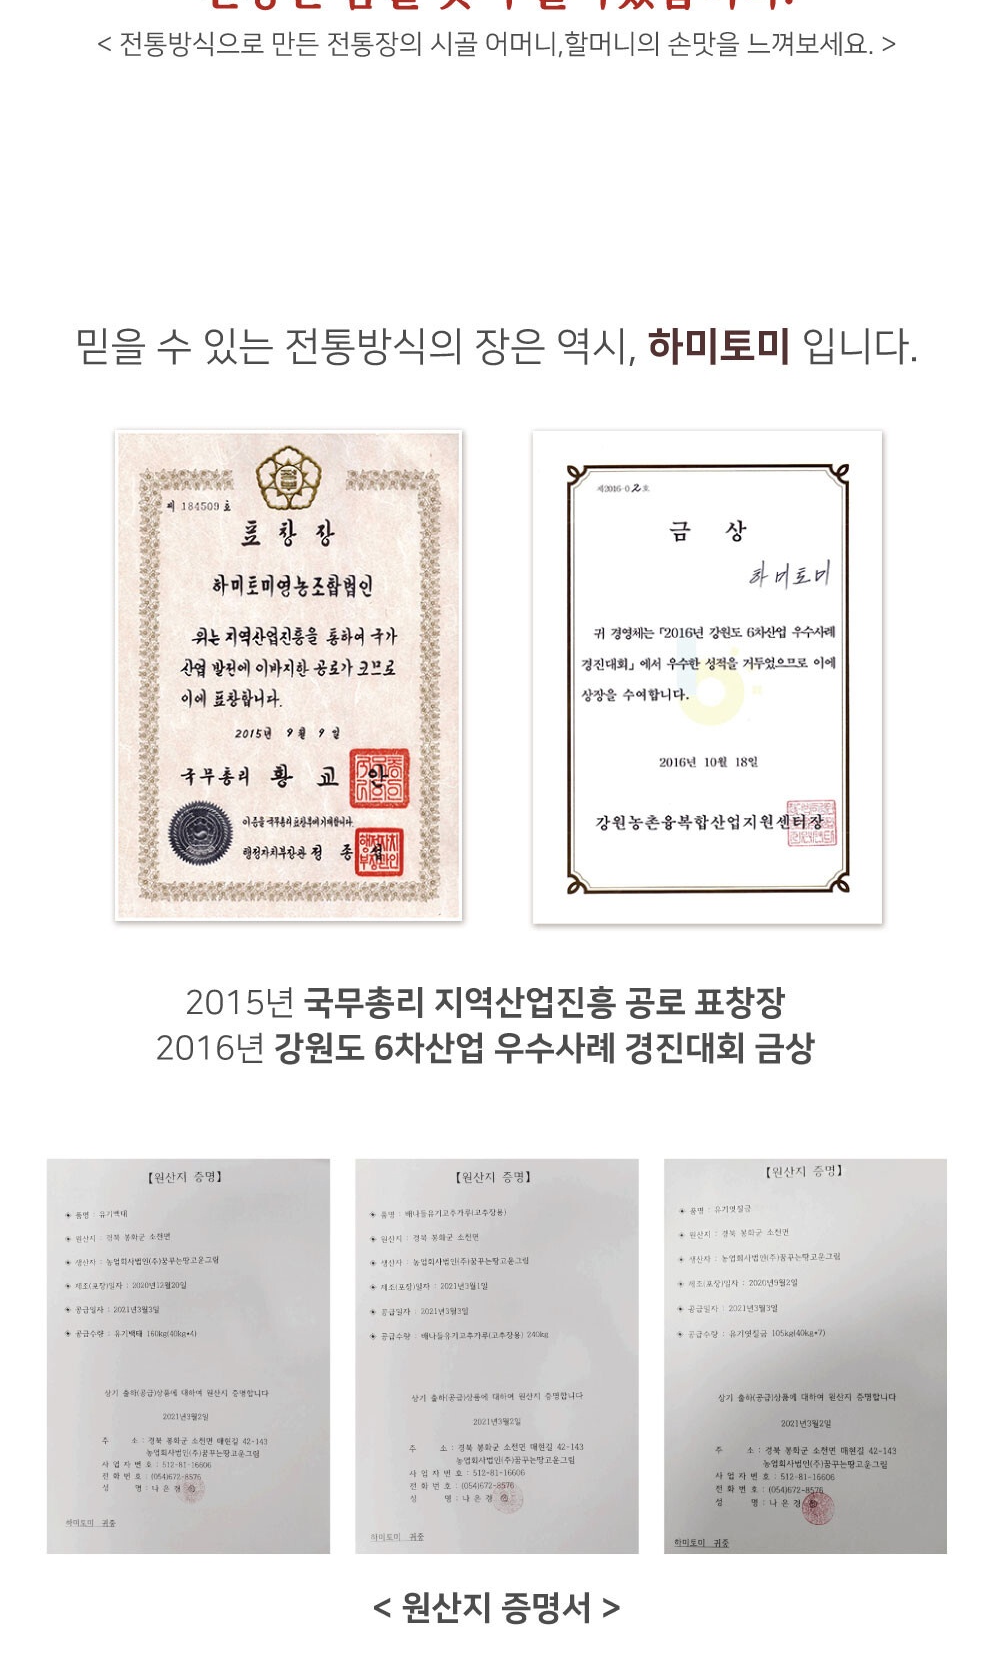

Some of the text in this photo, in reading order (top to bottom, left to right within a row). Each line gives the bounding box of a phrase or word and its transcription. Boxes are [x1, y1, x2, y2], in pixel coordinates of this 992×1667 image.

[213, 574, 372, 598] 하미토미영농조합법인
[192, 626, 398, 647] 위는 지역산업진흥을 통하여 국가
[611, 627, 655, 640] 경영체는
[660, 626, 703, 639] 「2016년
[709, 626, 742, 639] 강원도
[747, 626, 786, 639] 6차산업
[792, 625, 835, 638] 우수사례
[180, 658, 396, 678] 산업 발전에 이바지한 공로가 크므로
[582, 656, 836, 671] 경진대회」 에서 우수한 성적을 거두었으므로 이에
[181, 688, 282, 708] 이에 표창합니다.
[582, 688, 689, 702] 상장을 수여합니다.
[660, 756, 758, 767] 2016년 10월 18일
[596, 814, 824, 832] 강원농촌융복합산업지원센터장
